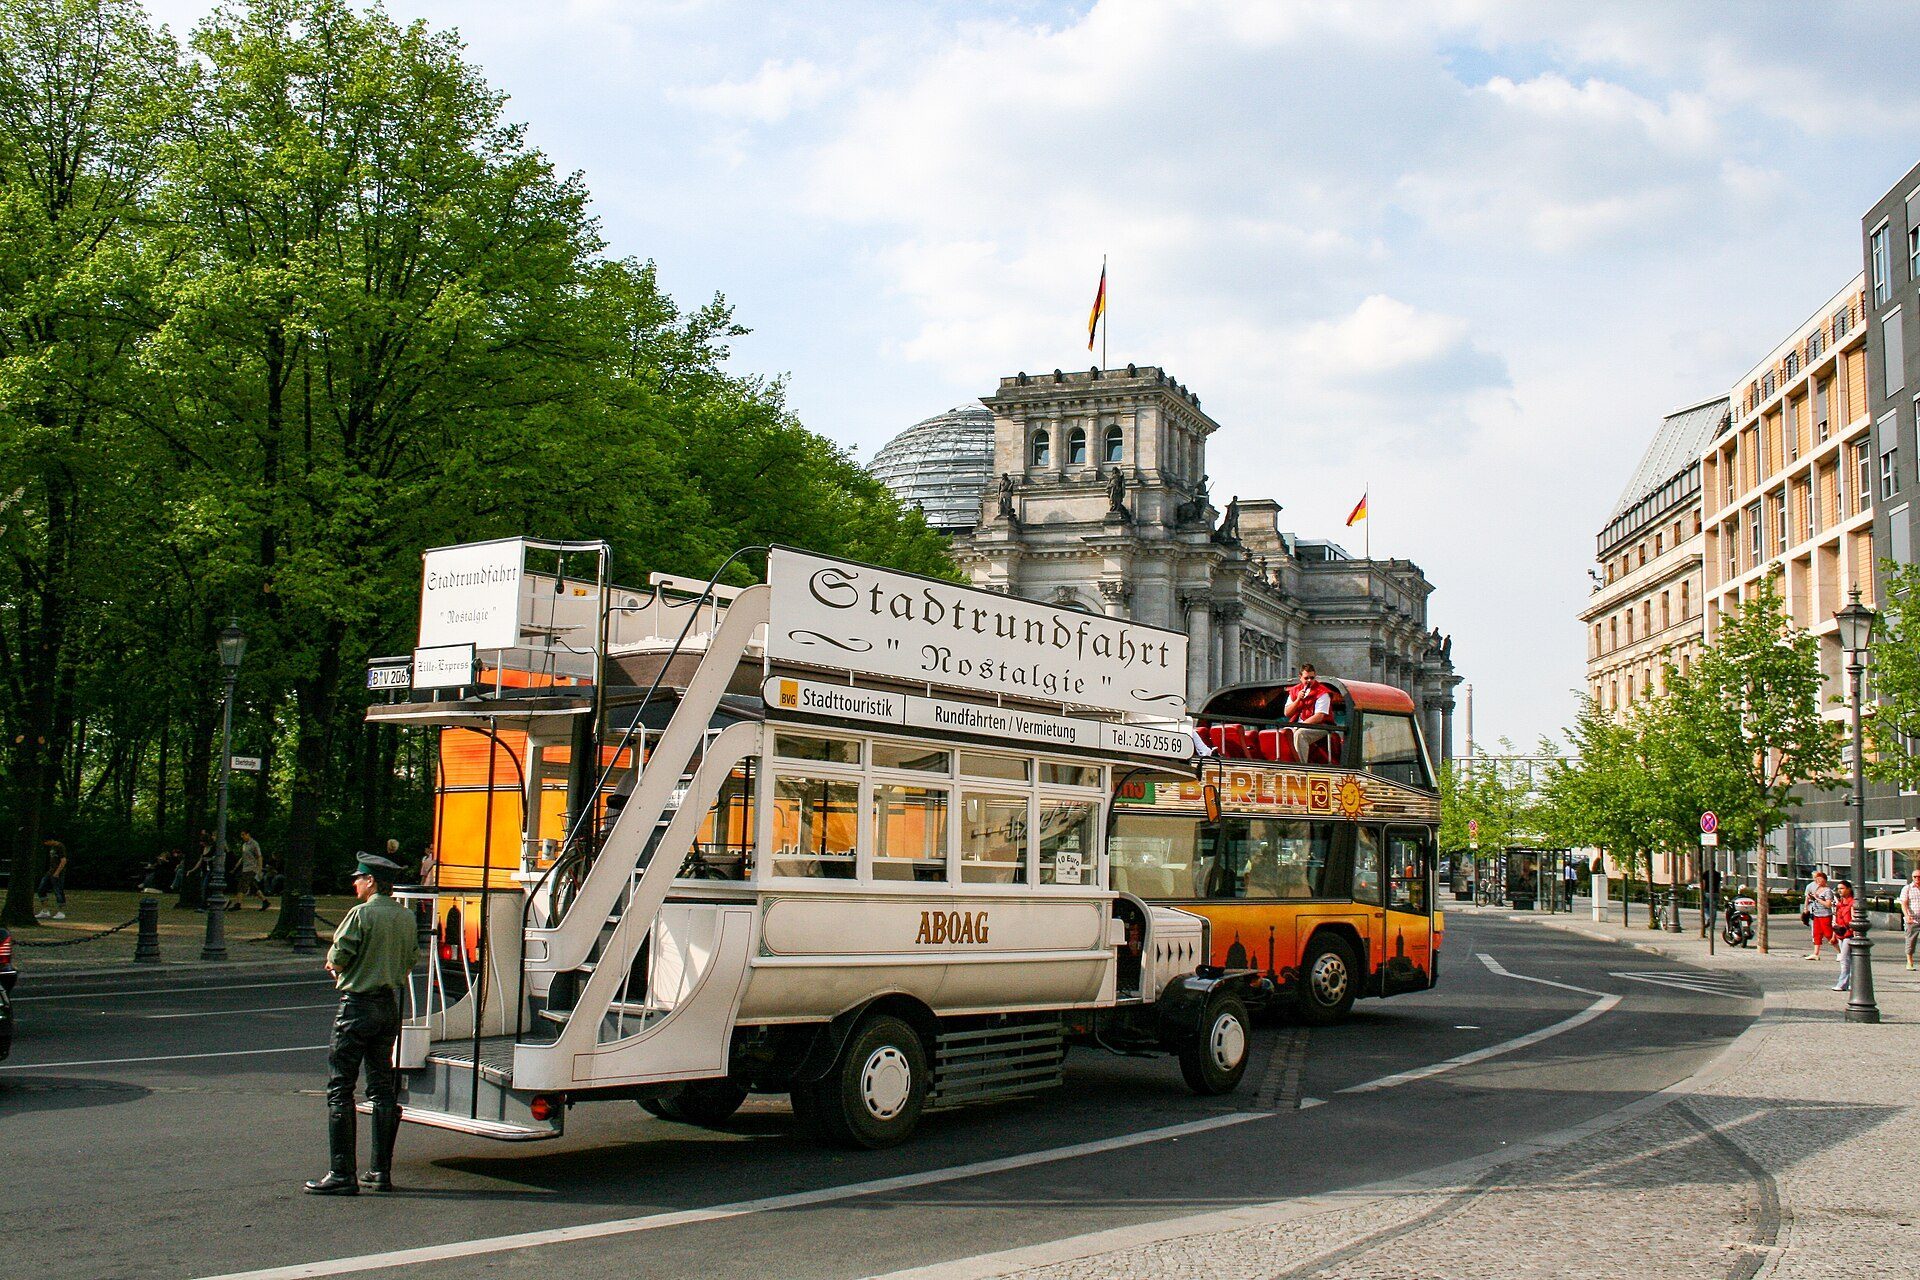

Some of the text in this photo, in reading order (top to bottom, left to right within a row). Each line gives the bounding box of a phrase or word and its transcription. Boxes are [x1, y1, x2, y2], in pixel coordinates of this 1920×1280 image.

[427, 563, 516, 590] Stadtrundfahrt
[446, 607, 489, 624] Nostalgie
[808, 567, 1171, 669] Stadtrundfahrt
[418, 660, 469, 673] Zille-Express
[921, 644, 1086, 696] Nostalgie
[781, 692, 797, 706] BVG
[803, 688, 893, 717] Stadttouristik
[936, 705, 1006, 730] Rundfahrten
[1015, 717, 1076, 743] Vermietung
[1112, 729, 1183, 753] Tel.: 256 255 69
[1179, 769, 1307, 805] BERLIN
[1057, 854, 1080, 866] 10 Euro
[915, 911, 990, 944] ABOAG
